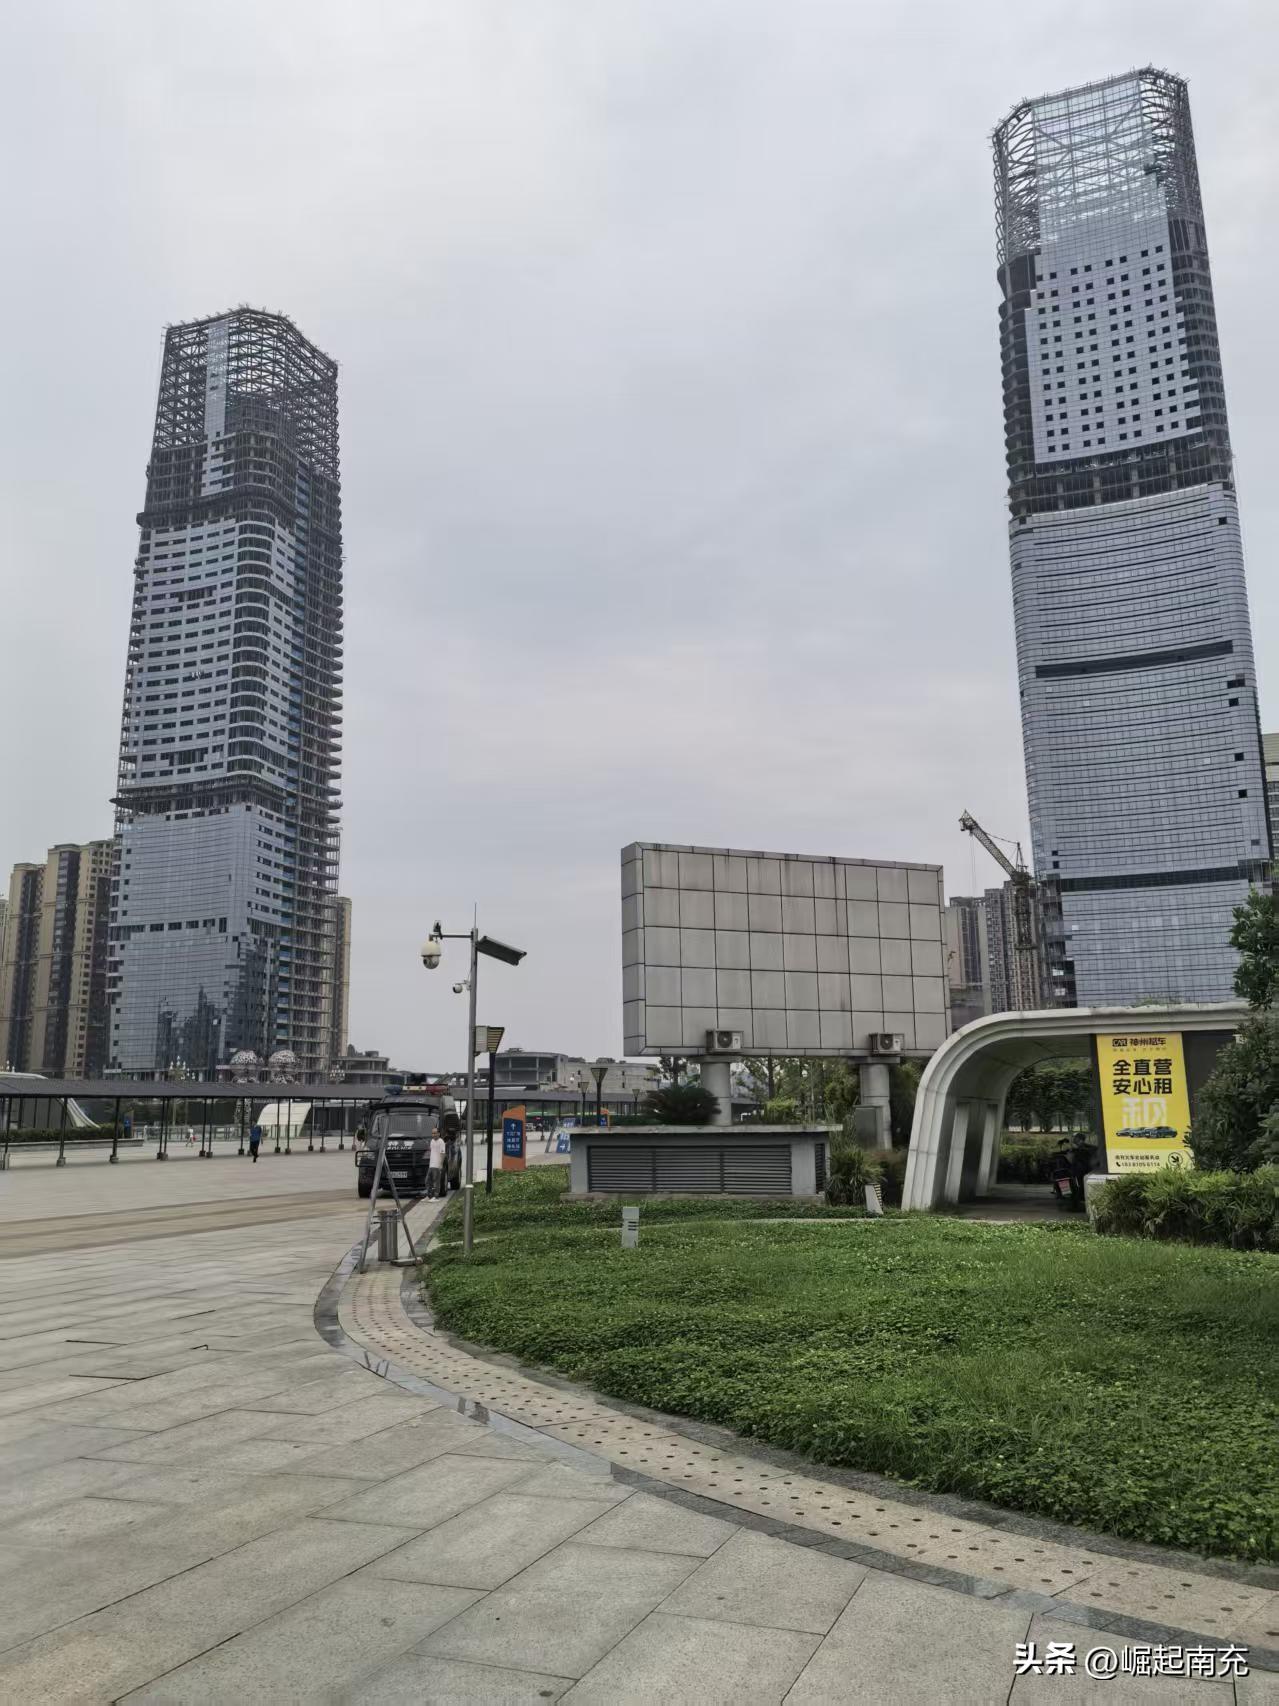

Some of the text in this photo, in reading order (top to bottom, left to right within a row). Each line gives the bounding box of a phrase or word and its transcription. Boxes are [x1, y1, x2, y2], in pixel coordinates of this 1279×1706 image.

[1129, 1037, 1166, 1046] 神州租车
[1113, 1059, 1172, 1076] 全直营
[1113, 1078, 1172, 1095] 安心租
